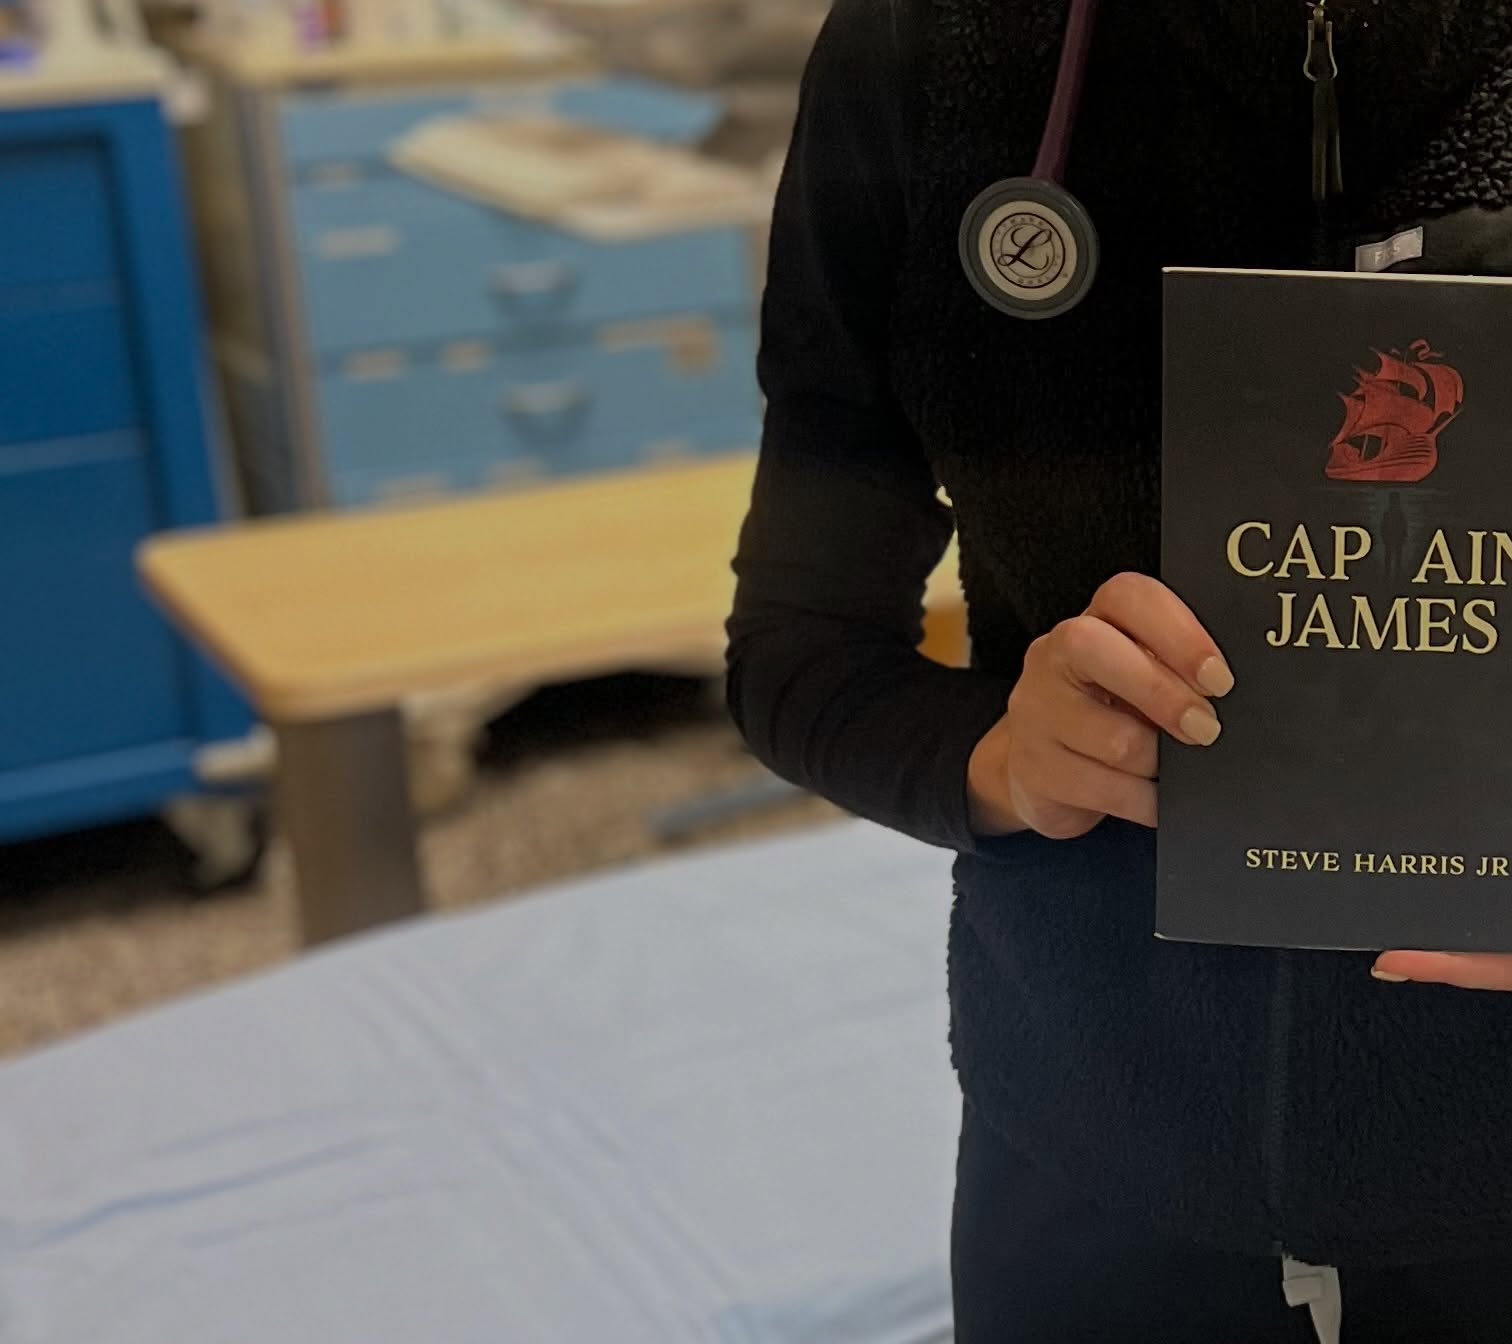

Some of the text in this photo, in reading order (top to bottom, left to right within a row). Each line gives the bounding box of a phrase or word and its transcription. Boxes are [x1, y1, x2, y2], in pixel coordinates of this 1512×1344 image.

[1266, 592, 1498, 654] JAMES
[1246, 848, 1510, 877] STEVE HARRIS JR
